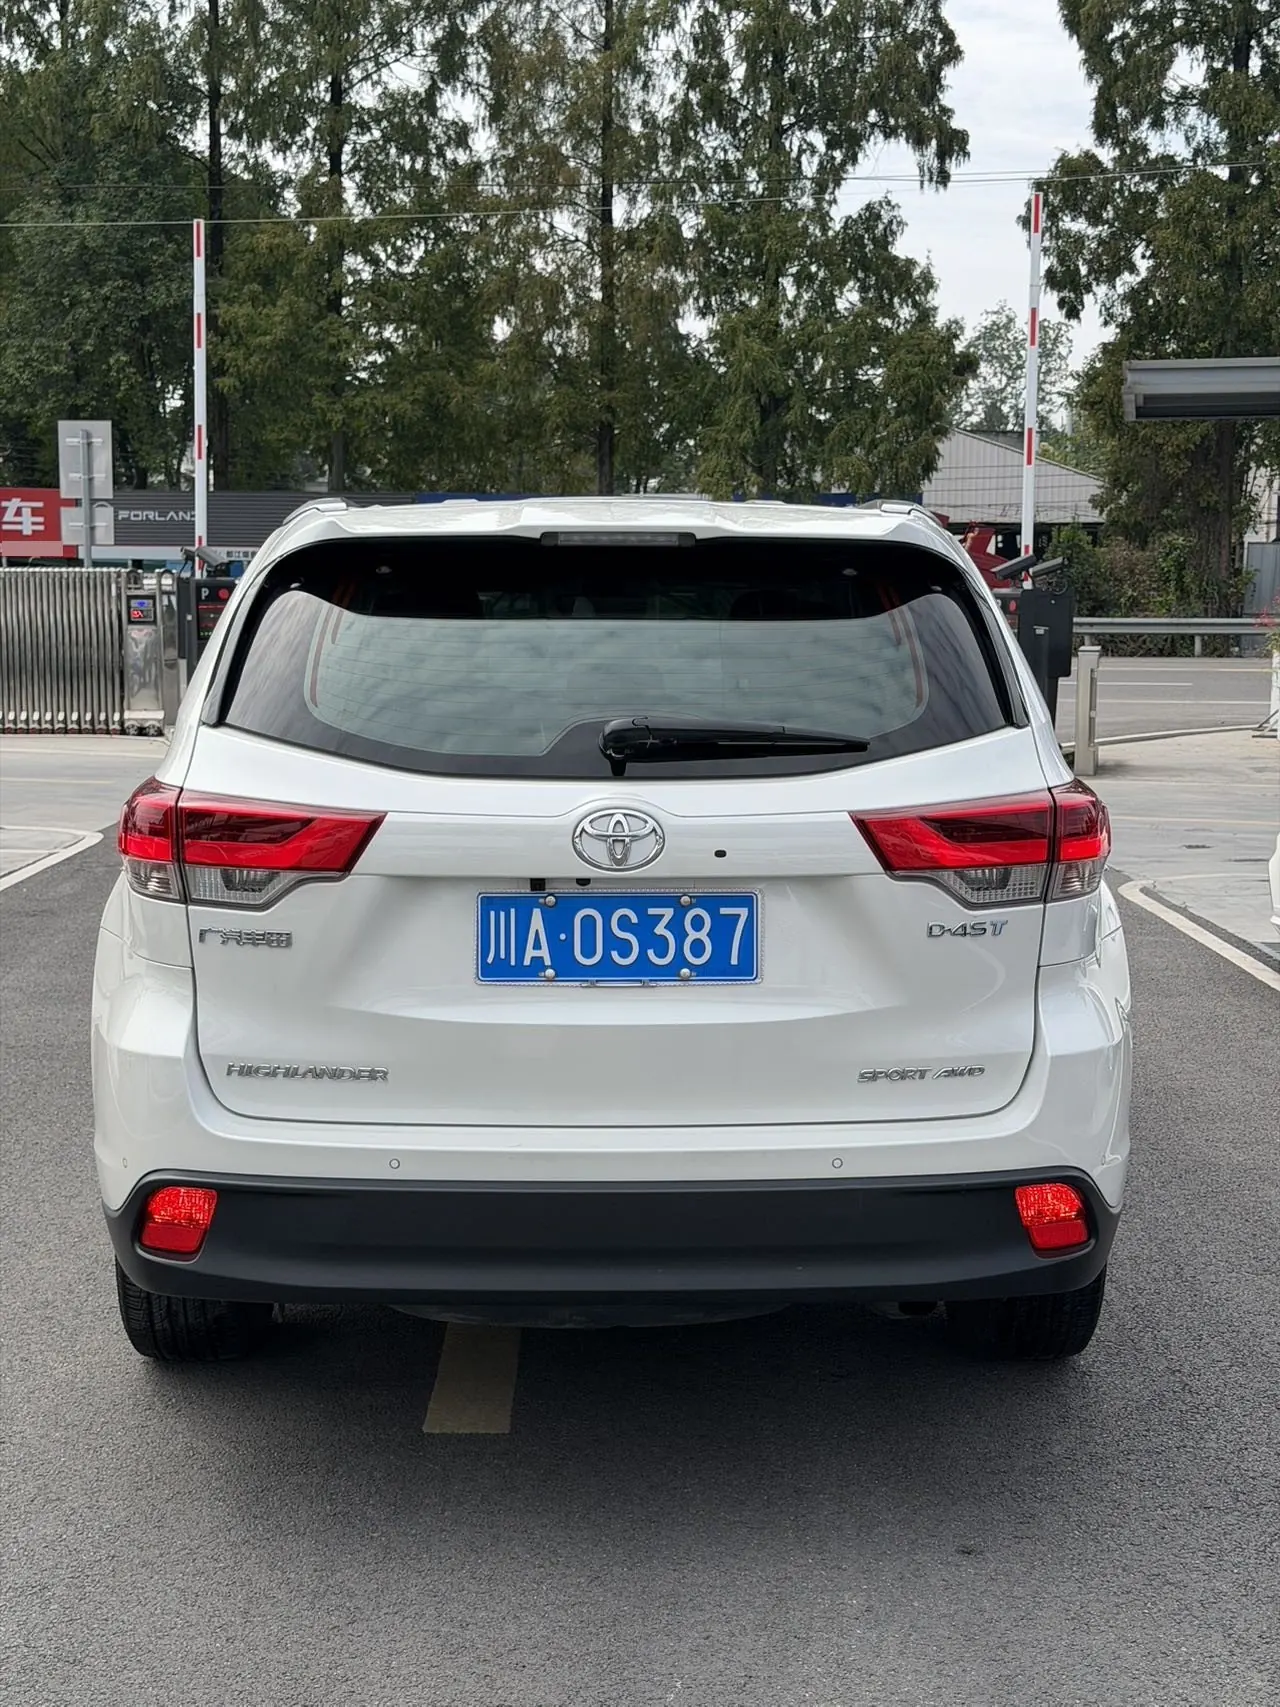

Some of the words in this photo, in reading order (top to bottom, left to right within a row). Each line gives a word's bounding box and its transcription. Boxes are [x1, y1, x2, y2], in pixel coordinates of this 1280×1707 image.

[1, 498, 45, 535] 车
[201, 587, 210, 600] P
[199, 927, 292, 948] 广汽丰田
[226, 1062, 389, 1081] HIGHLANDER
[858, 1067, 932, 1083] SPORT
[932, 1065, 985, 1080] AWD
